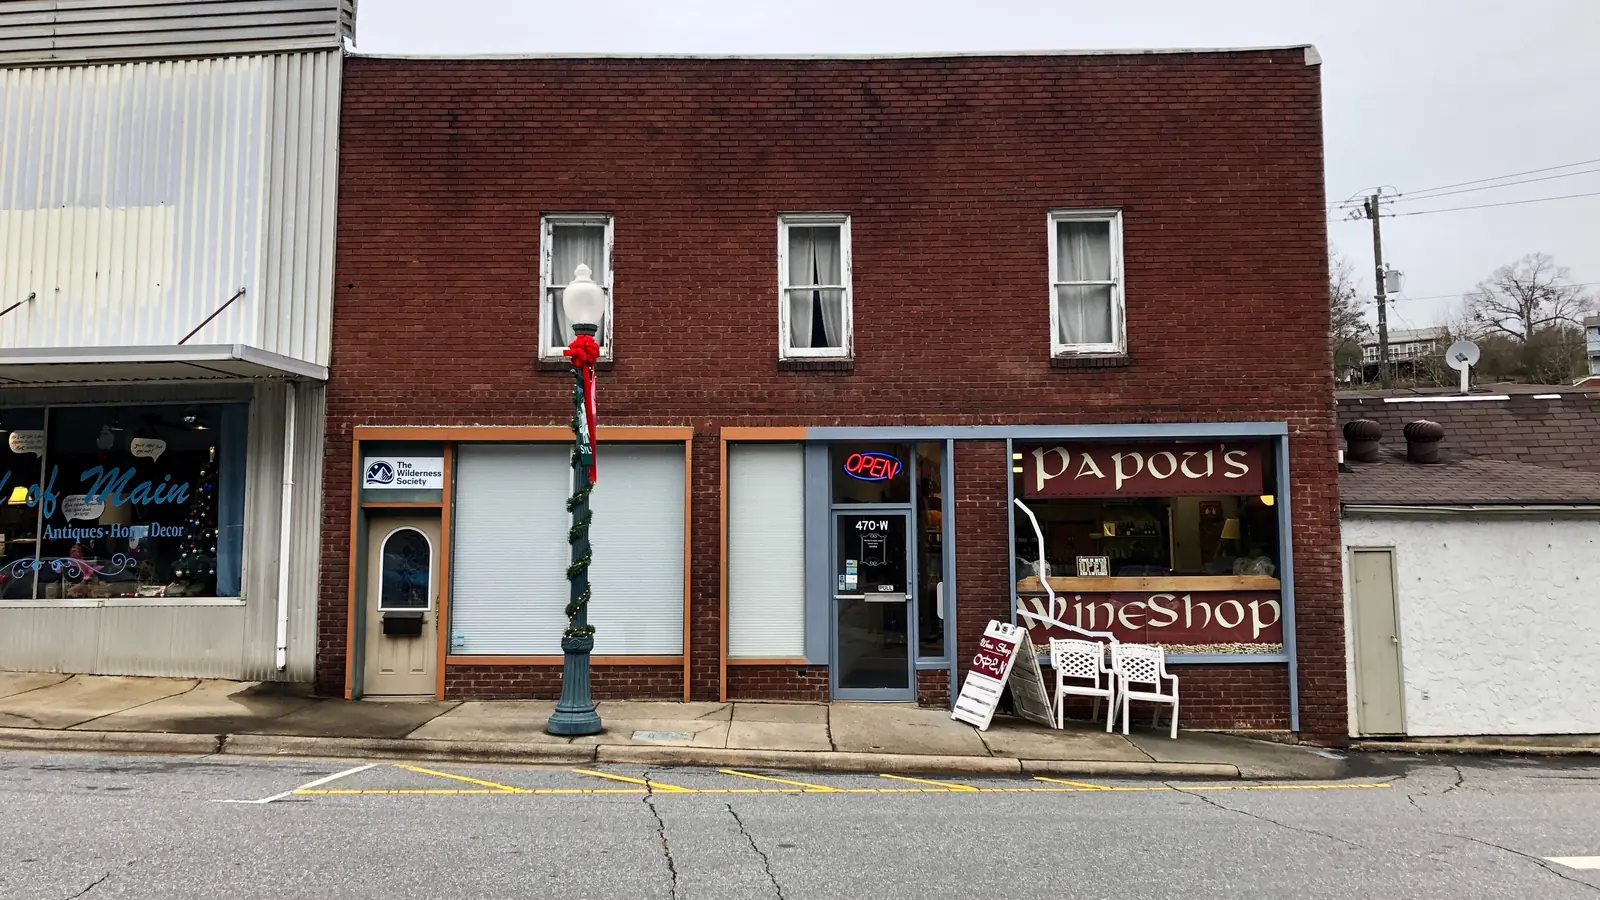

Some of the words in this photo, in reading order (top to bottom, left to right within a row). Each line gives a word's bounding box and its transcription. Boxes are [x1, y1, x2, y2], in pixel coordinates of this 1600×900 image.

[580, 444, 592, 454] SYL
[397, 461, 412, 469] The
[846, 453, 898, 479] OPEN
[397, 469, 442, 477] Wilderness
[80, 465, 190, 508] Main
[396, 477, 427, 486] Society
[151, 521, 184, 538] Decor
[855, 520, 889, 531] 470-W
[1079, 562, 1107, 572] OPEN
[996, 643, 1012, 657] Shop
[973, 653, 1009, 675] OPEN
